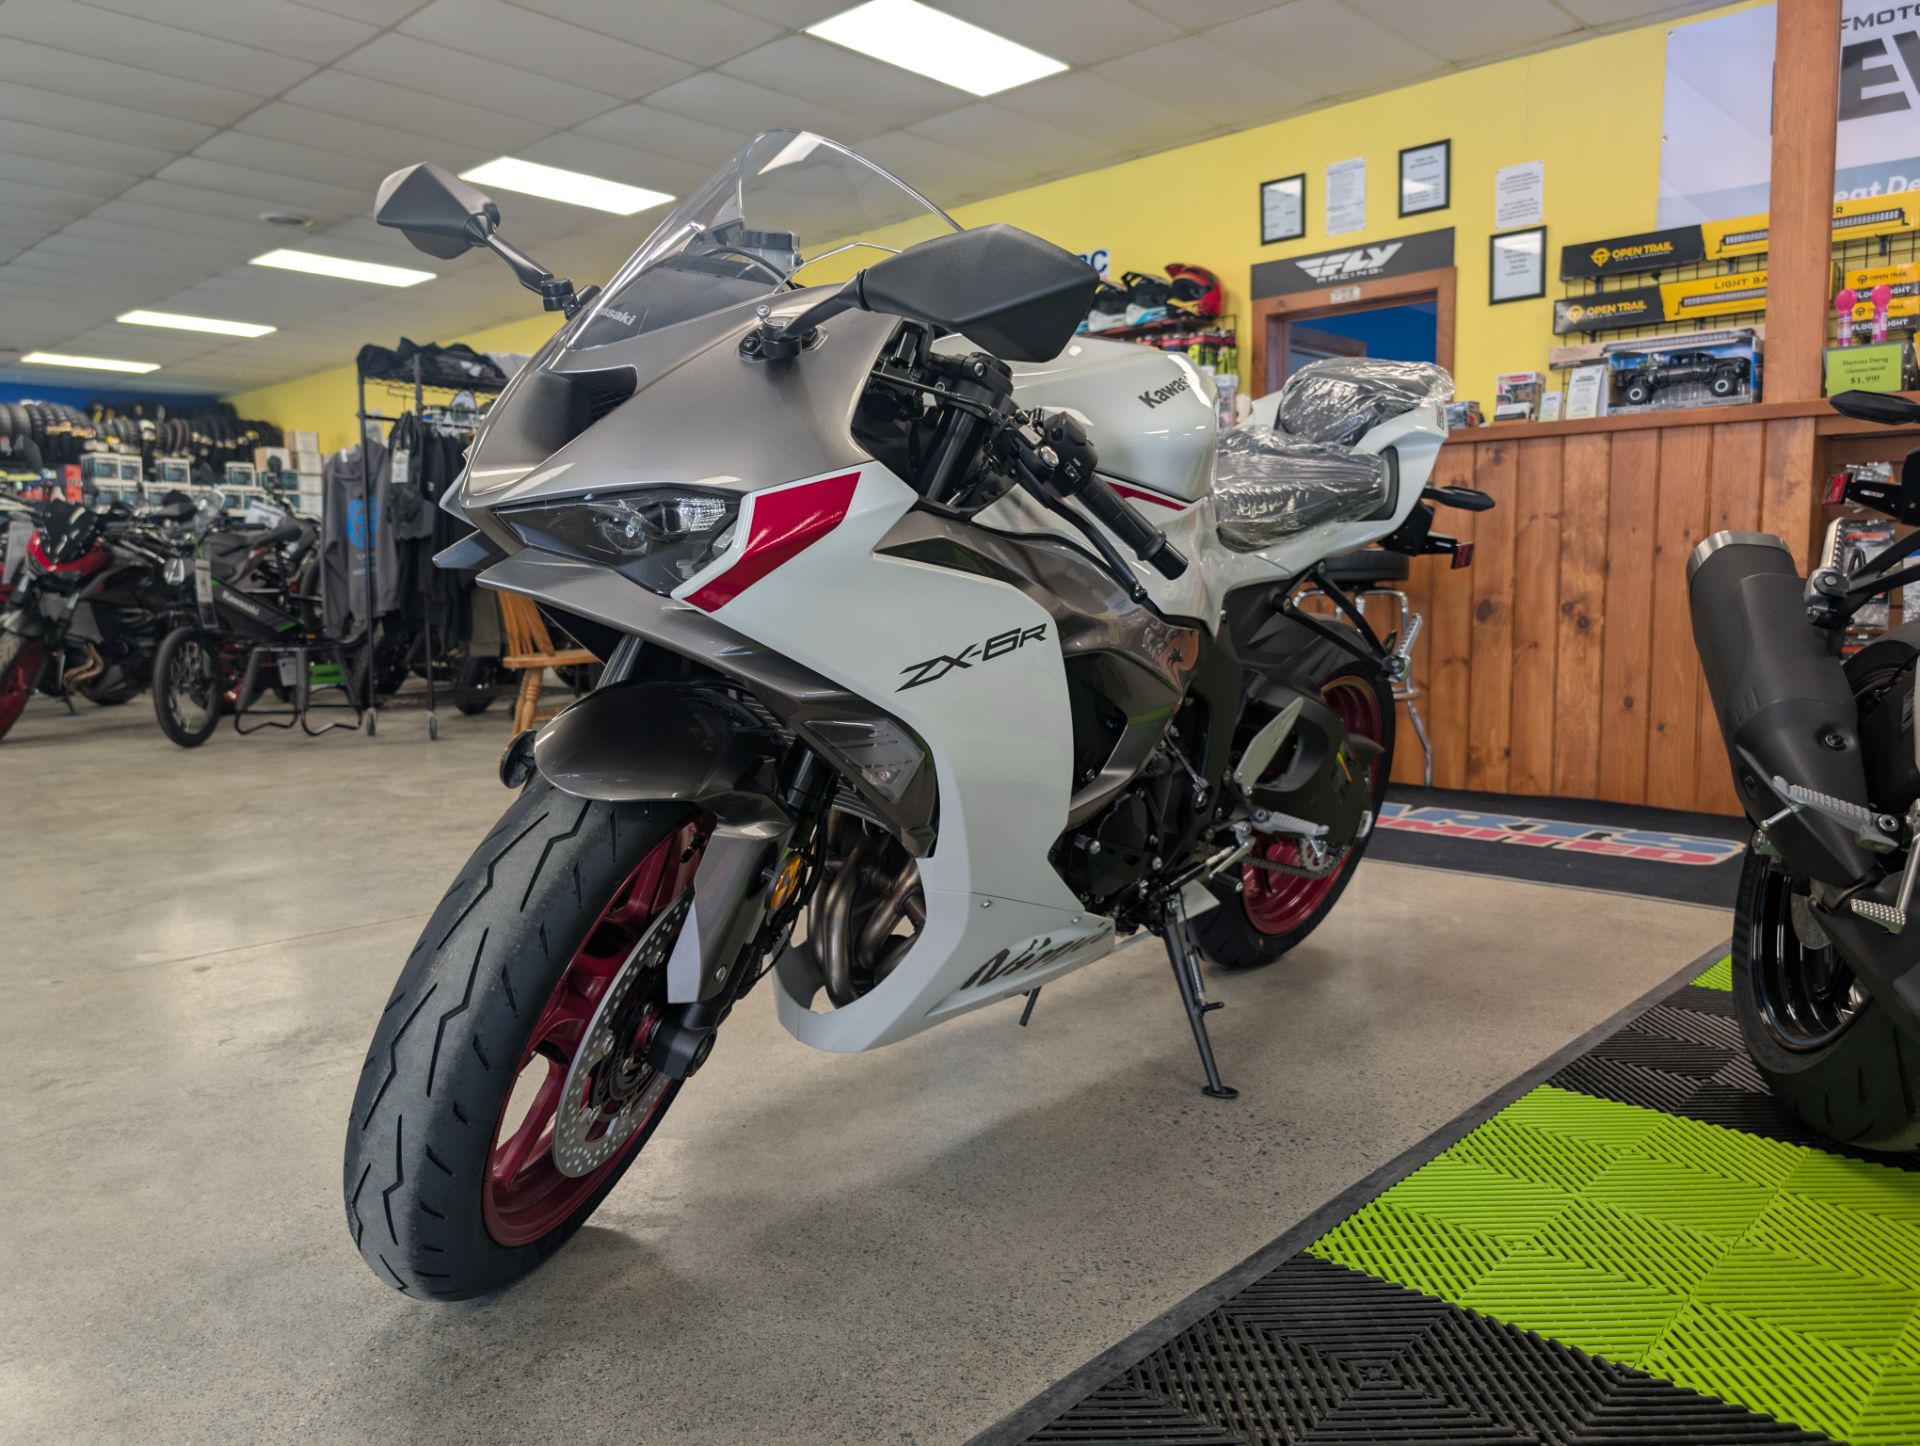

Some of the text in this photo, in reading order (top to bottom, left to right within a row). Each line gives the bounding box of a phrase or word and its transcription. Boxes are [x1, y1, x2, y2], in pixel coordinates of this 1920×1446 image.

[1834, 181, 1881, 202] eat
[1612, 246, 1642, 258] OPEN
[1643, 241, 1674, 254] TRAIL
[1312, 242, 1403, 277] FLY
[1316, 267, 1378, 284] RACING
[1714, 275, 1768, 289] LIGHT BA
[1587, 304, 1617, 316] OPEN
[1617, 300, 1648, 312] TRAIL
[1138, 375, 1190, 409] Kawas
[895, 623, 1047, 693] ZX-6R
